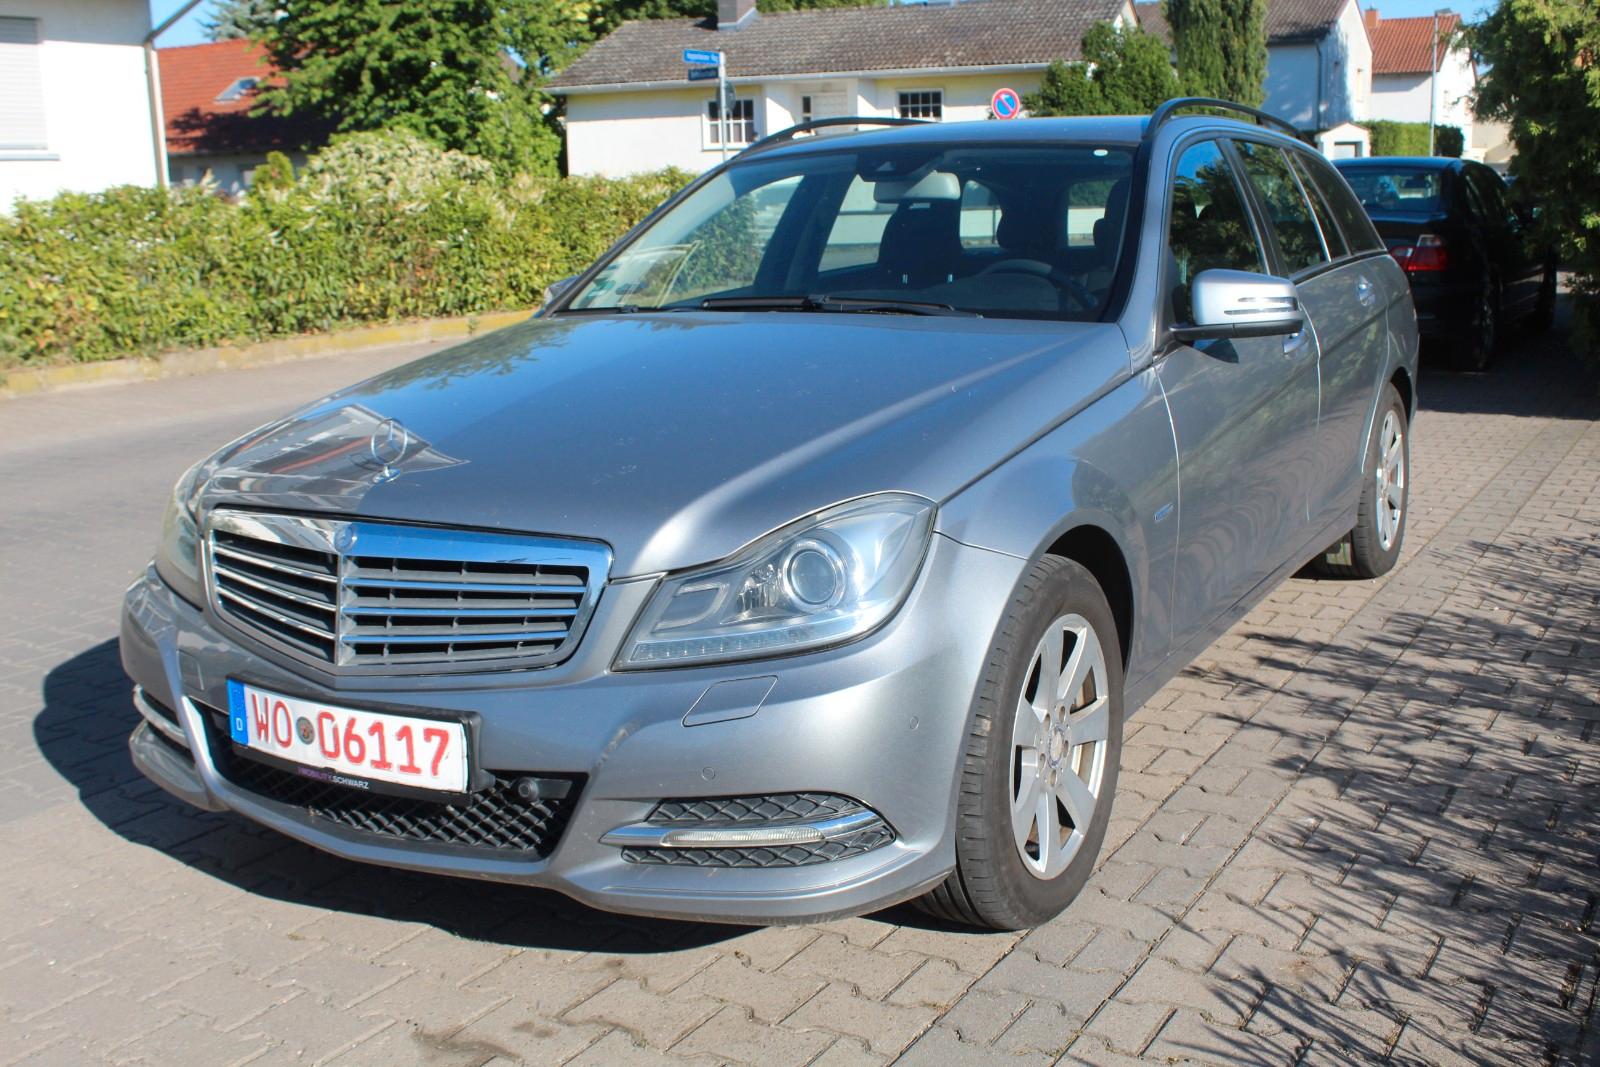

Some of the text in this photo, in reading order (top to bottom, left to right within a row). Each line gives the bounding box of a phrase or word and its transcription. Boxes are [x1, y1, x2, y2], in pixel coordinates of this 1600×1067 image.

[236, 717, 243, 731] D
[251, 693, 450, 777] WO 06117
